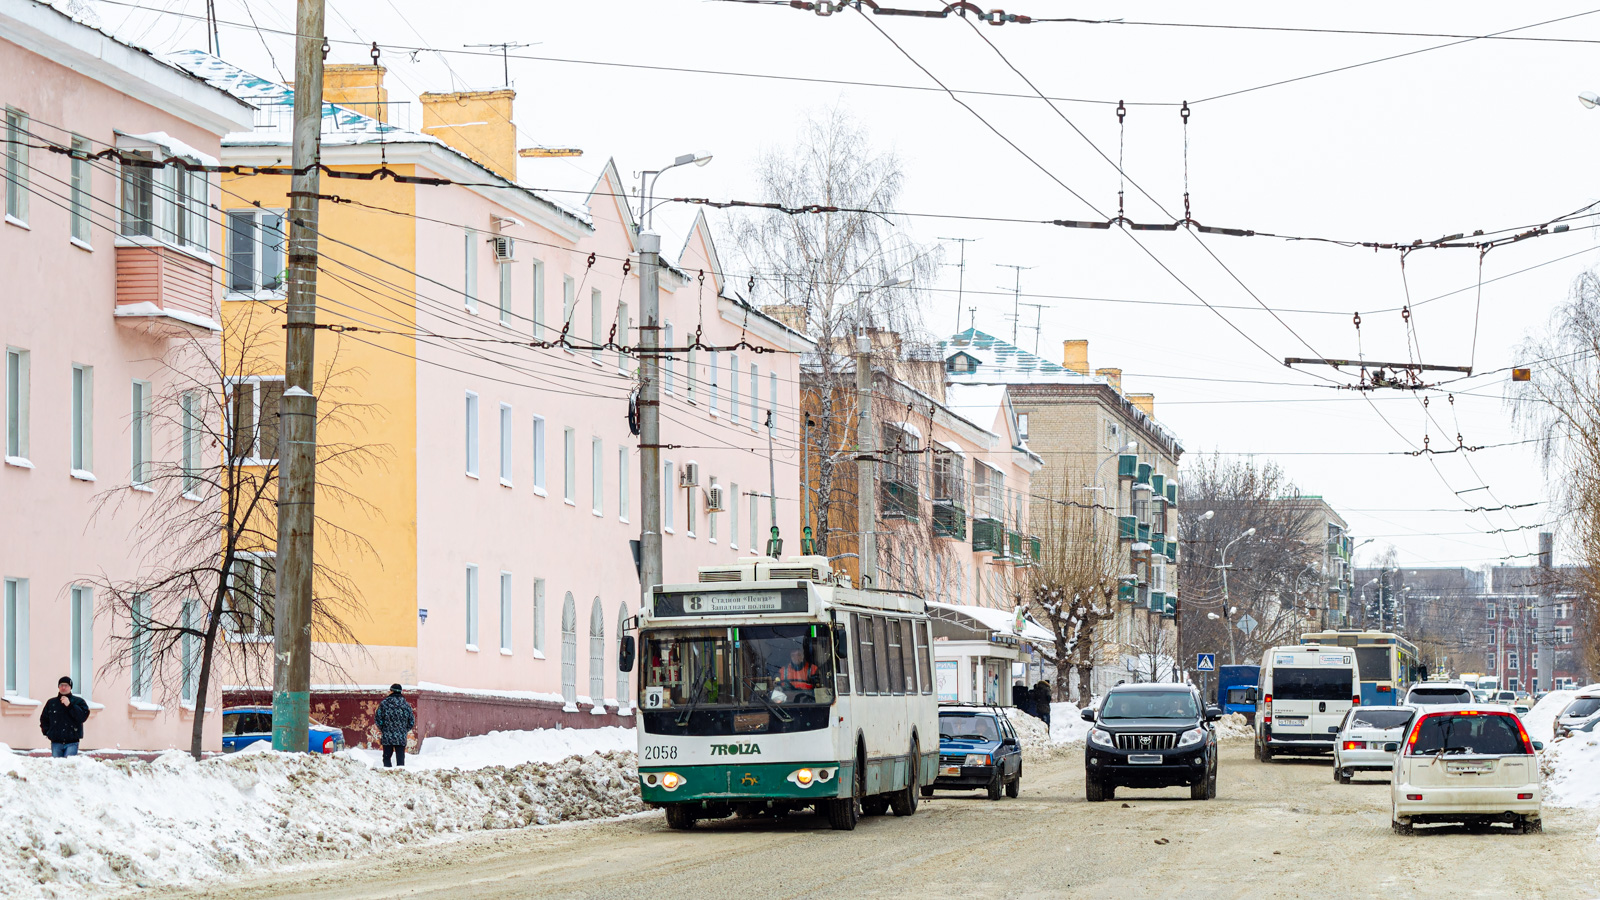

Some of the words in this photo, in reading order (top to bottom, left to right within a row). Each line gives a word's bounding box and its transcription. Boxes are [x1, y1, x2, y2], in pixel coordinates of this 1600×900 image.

[690, 596, 702, 610] 8
[711, 596, 741, 604] Стадион
[649, 693, 660, 707] 9
[645, 746, 678, 760] 2058
[710, 744, 761, 755] TROLZA
